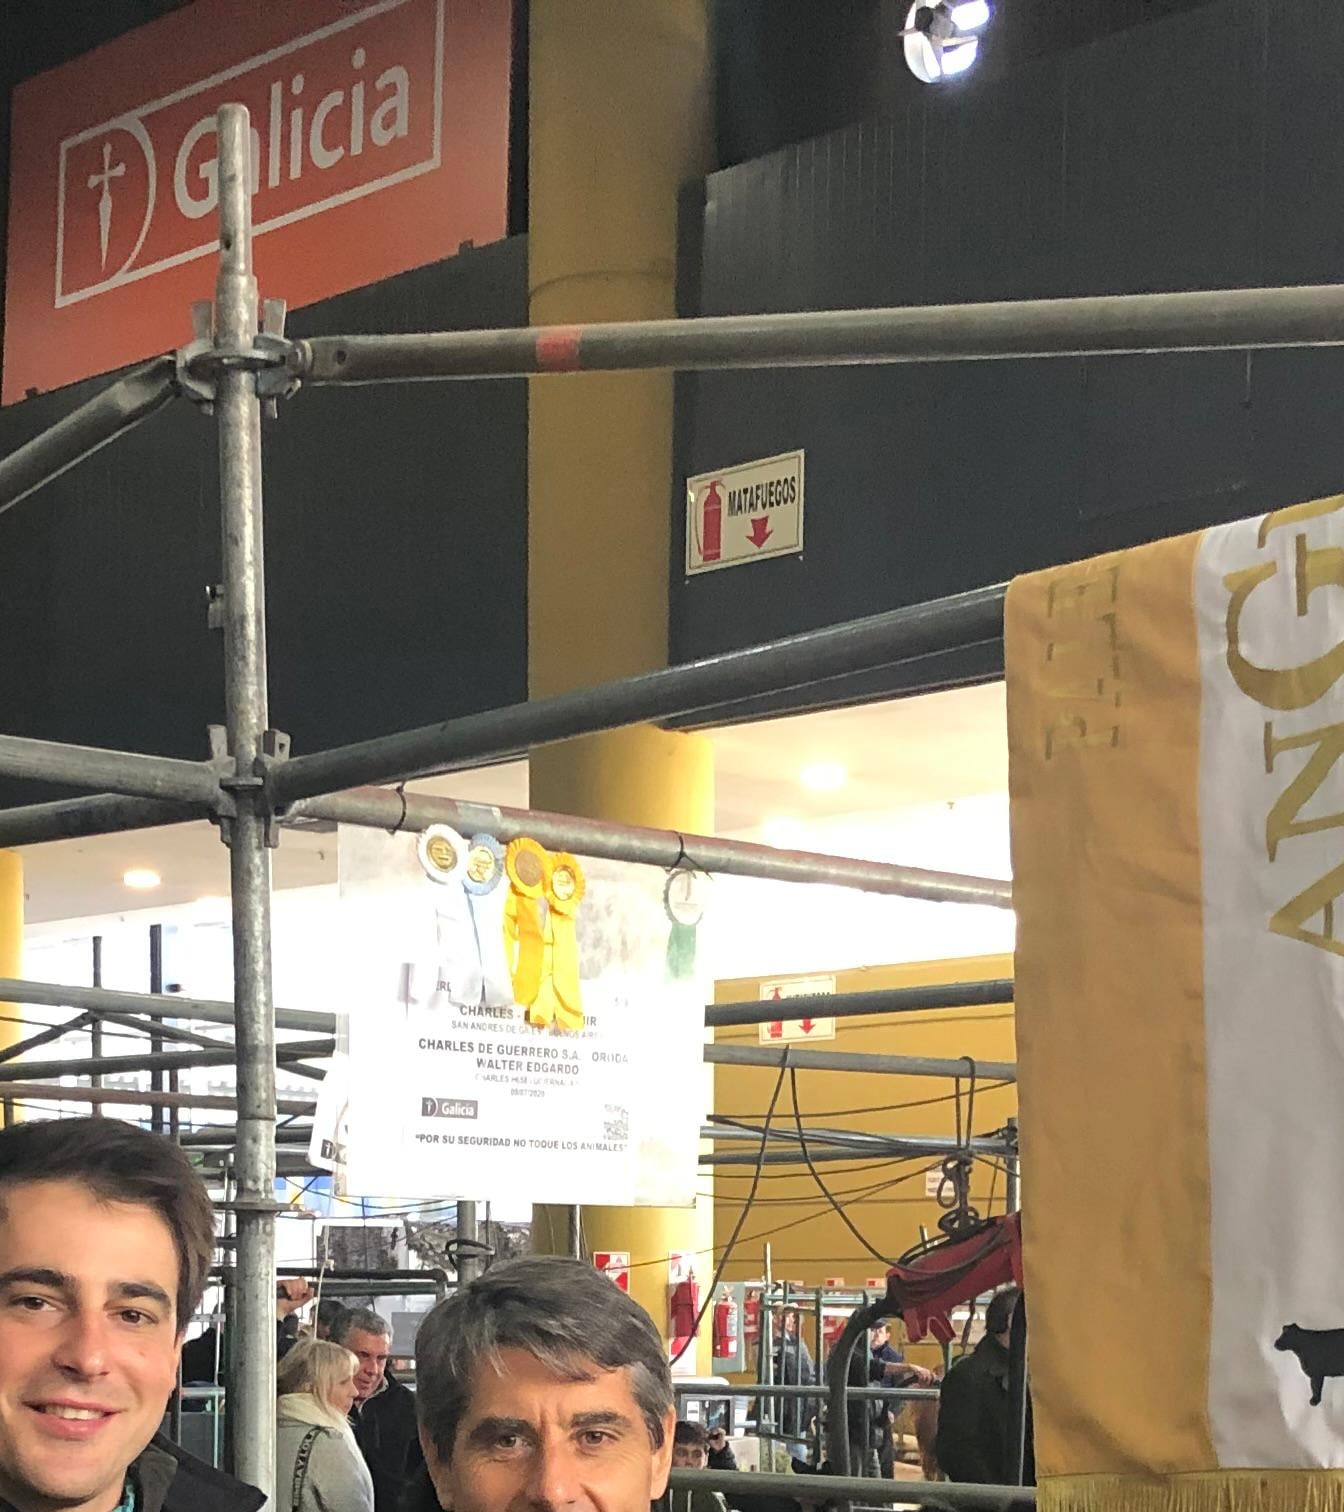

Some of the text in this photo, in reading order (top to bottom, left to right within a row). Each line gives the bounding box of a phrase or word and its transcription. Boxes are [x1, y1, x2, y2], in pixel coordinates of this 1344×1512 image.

[728, 476, 796, 517] MATAFUEGOS
[459, 1004, 514, 1020] CHARLES
[451, 1020, 469, 1030] SAN
[470, 1022, 504, 1033] ANDRES
[506, 1024, 517, 1035] DE
[418, 1037, 475, 1053] CHARLES
[478, 1042, 494, 1055] DE
[496, 1043, 559, 1060] GUERRERO
[476, 1057, 580, 1076] WALTER EDGARDO
[441, 1098, 475, 1117] Galicia
[442, 1135, 455, 1145] SU
[457, 1135, 511, 1147] SEGURIDAD
[513, 1137, 527, 1148] NO
[529, 1139, 559, 1150] TOQUE
[561, 1140, 578, 1151] LOS
